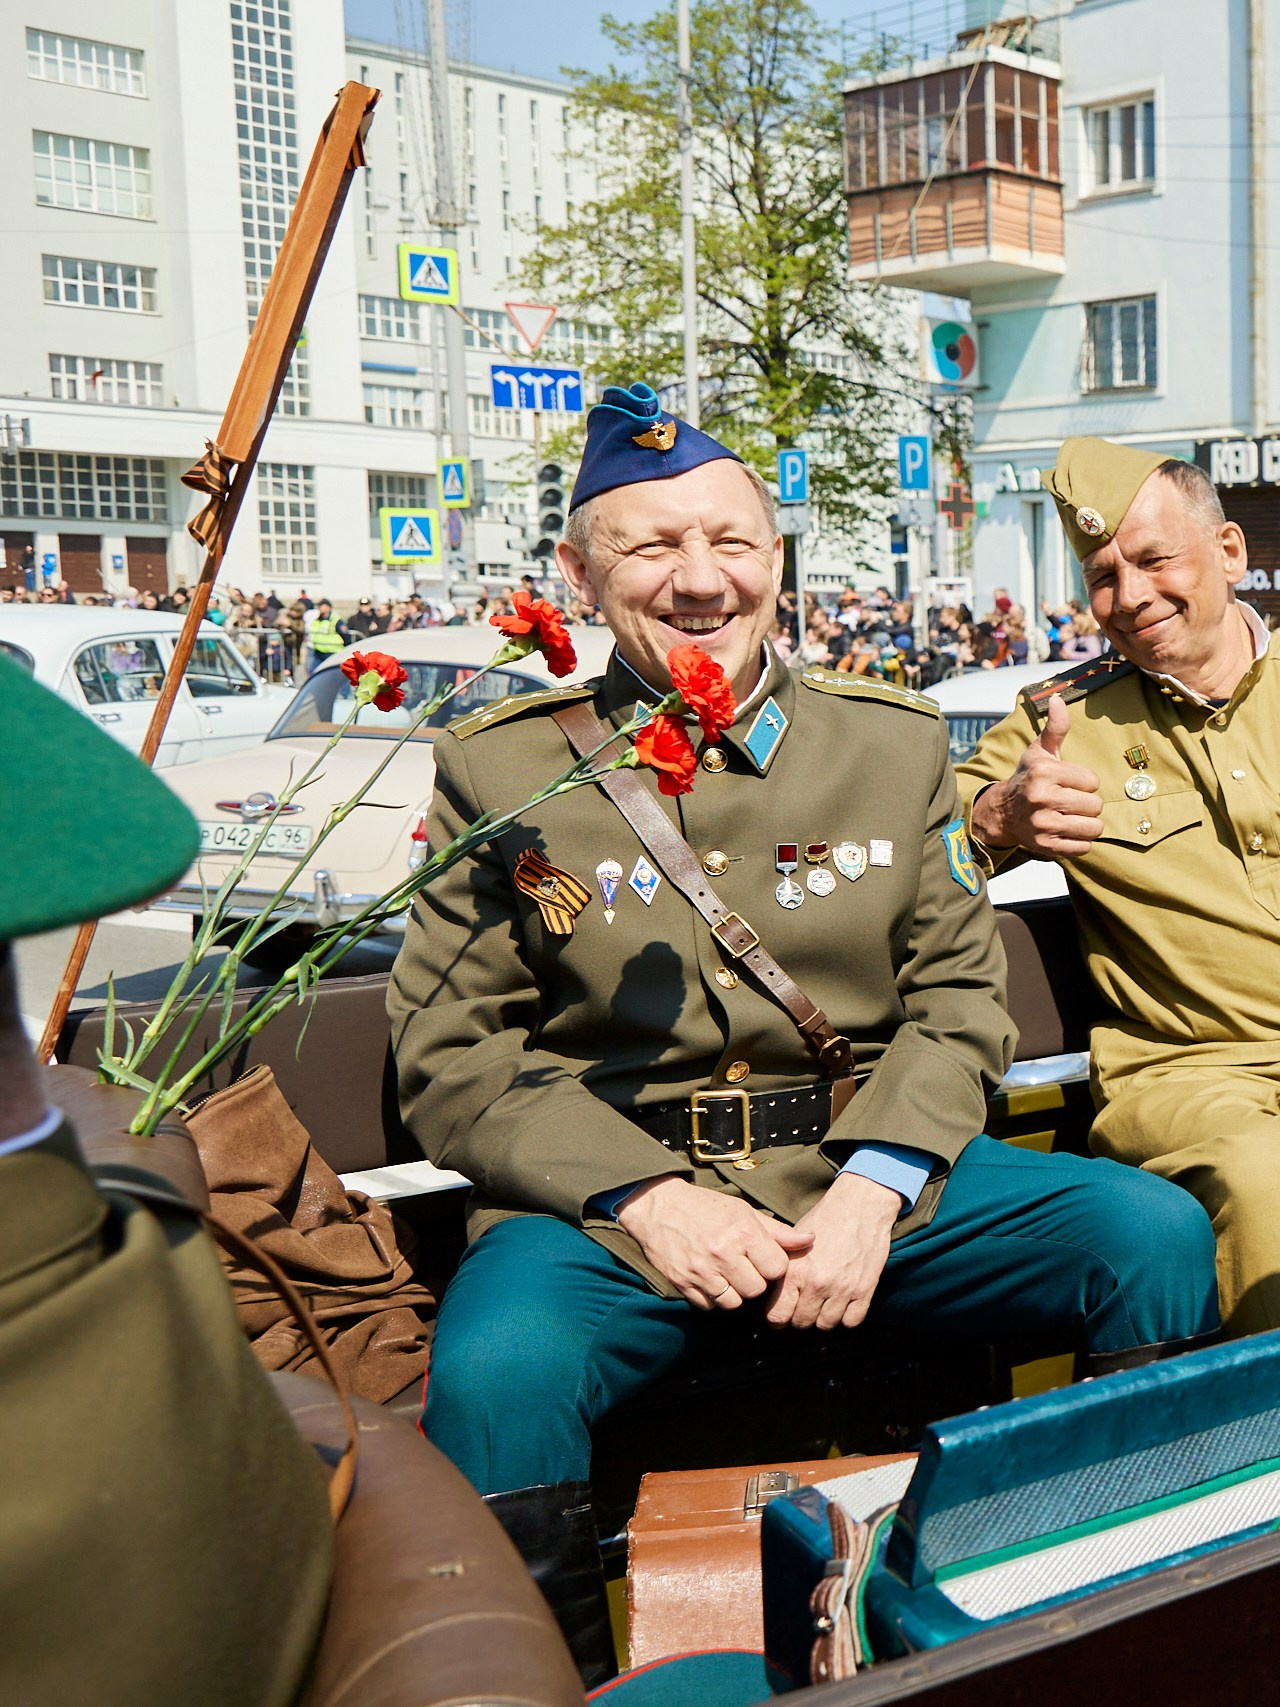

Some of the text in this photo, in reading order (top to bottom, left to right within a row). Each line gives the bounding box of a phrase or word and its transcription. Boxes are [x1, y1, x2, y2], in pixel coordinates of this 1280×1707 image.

[785, 455, 803, 497] P
[905, 442, 923, 484] P
[1210, 441, 1259, 485] RED
[1235, 569, 1272, 591] ВО.
[285, 828, 302, 844] 96
